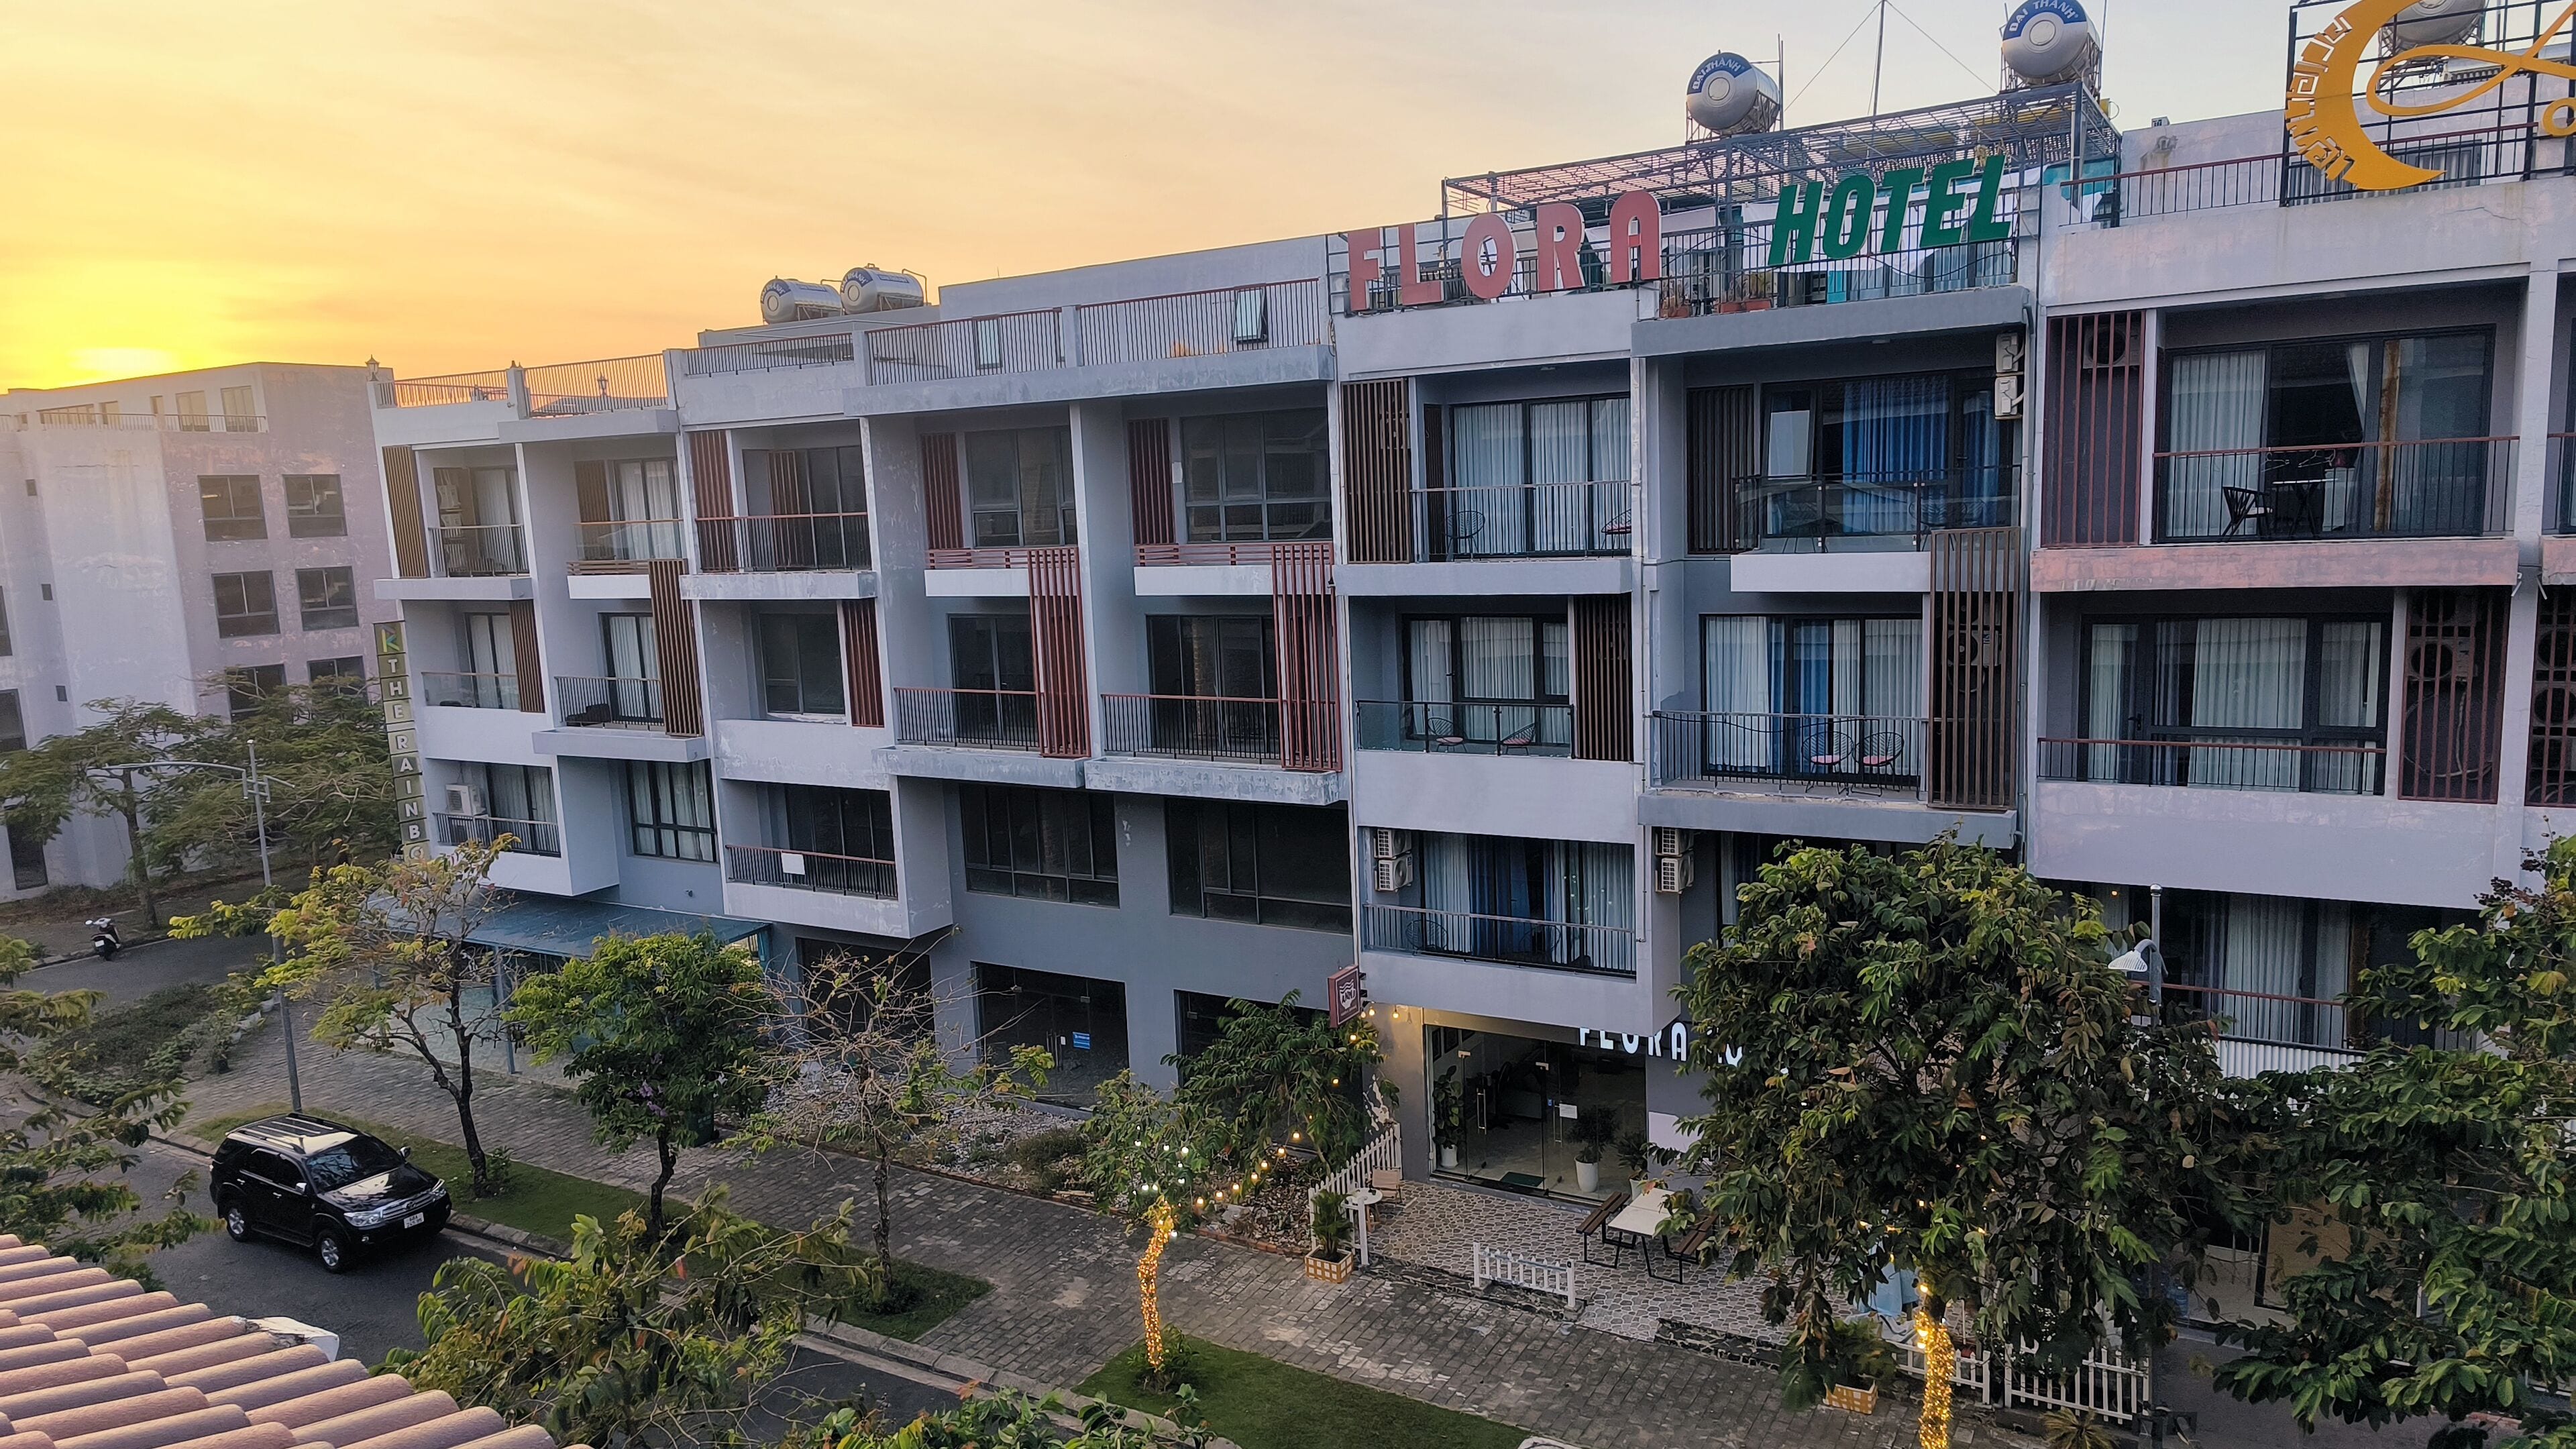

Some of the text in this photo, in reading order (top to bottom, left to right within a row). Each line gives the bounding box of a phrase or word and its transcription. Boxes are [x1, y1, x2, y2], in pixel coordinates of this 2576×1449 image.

[1347, 156, 2012, 311] FLORA HOTEL
[388, 658, 427, 879] THE RAINBO
